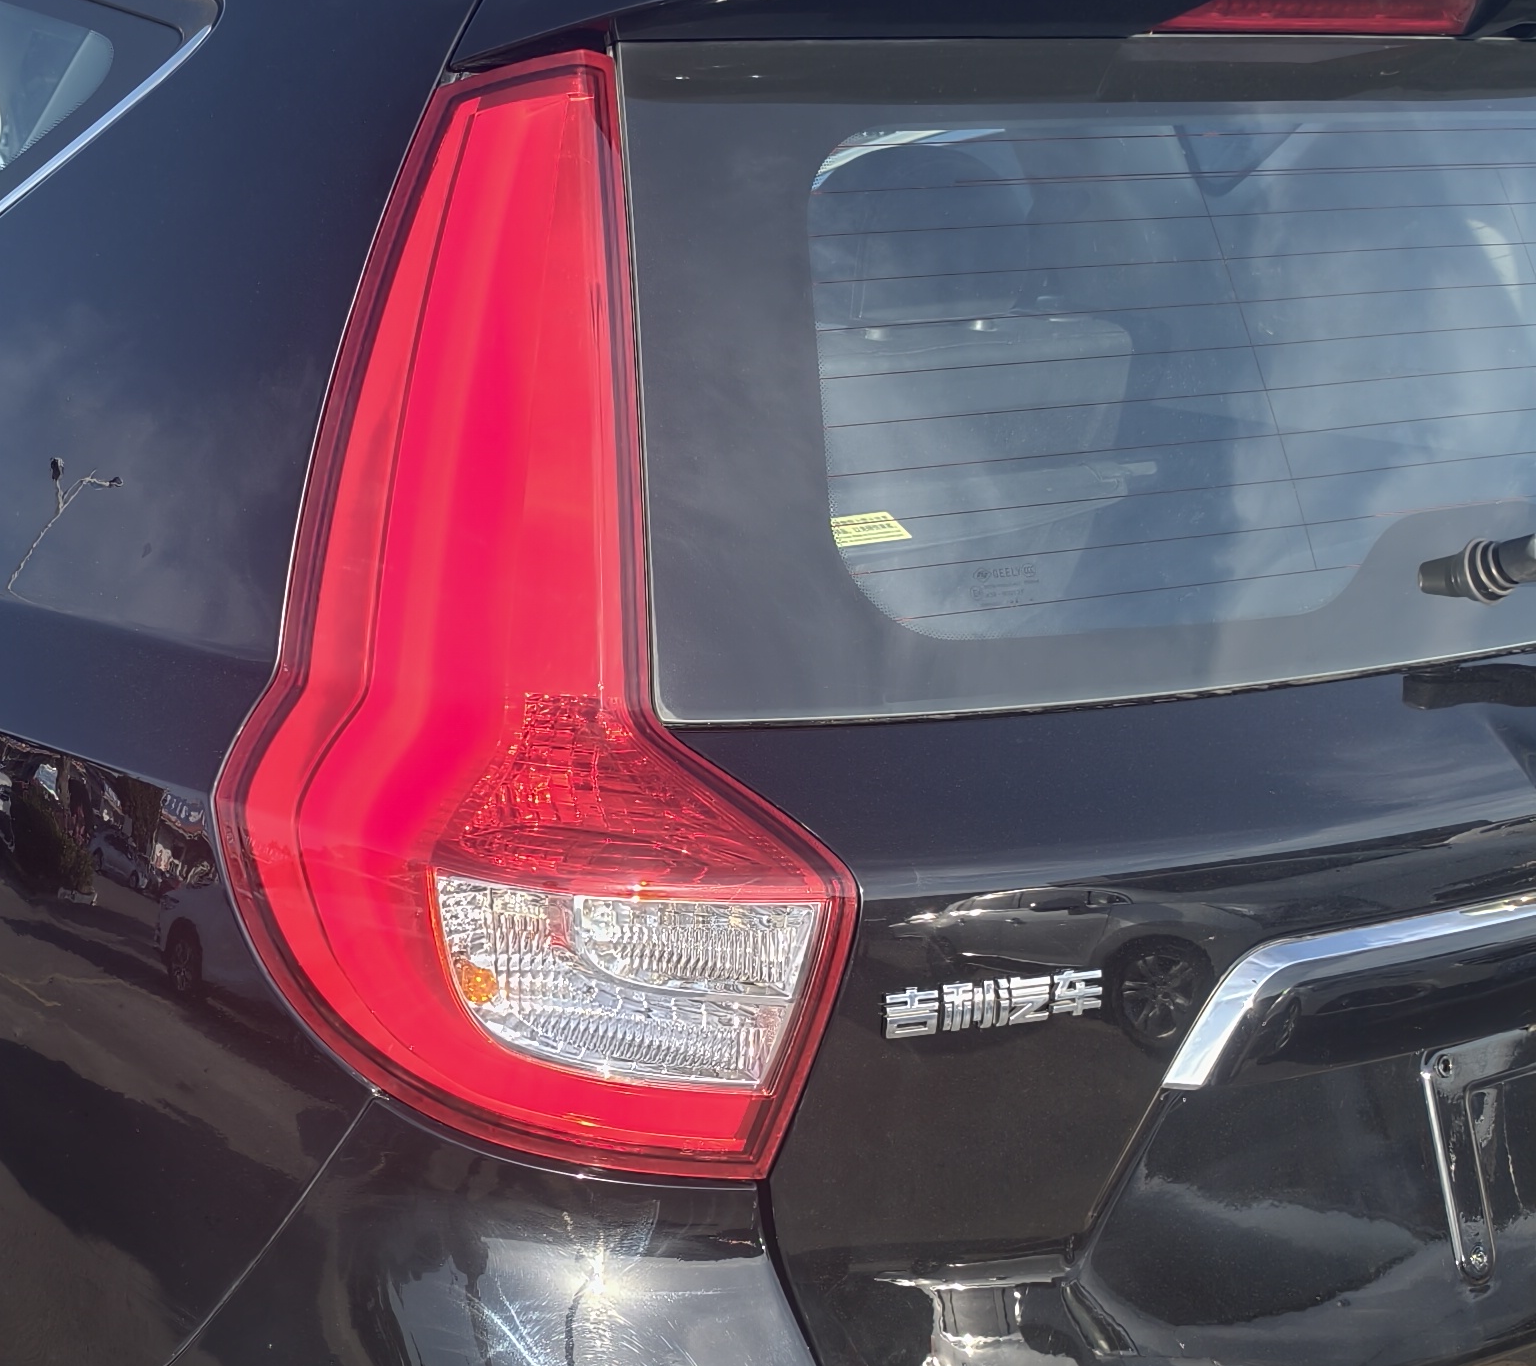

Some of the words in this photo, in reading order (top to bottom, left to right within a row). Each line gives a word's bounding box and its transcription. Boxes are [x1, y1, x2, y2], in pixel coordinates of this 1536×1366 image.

[992, 566, 1022, 579] GEELY
[883, 969, 1103, 1040] 吉利汽车
